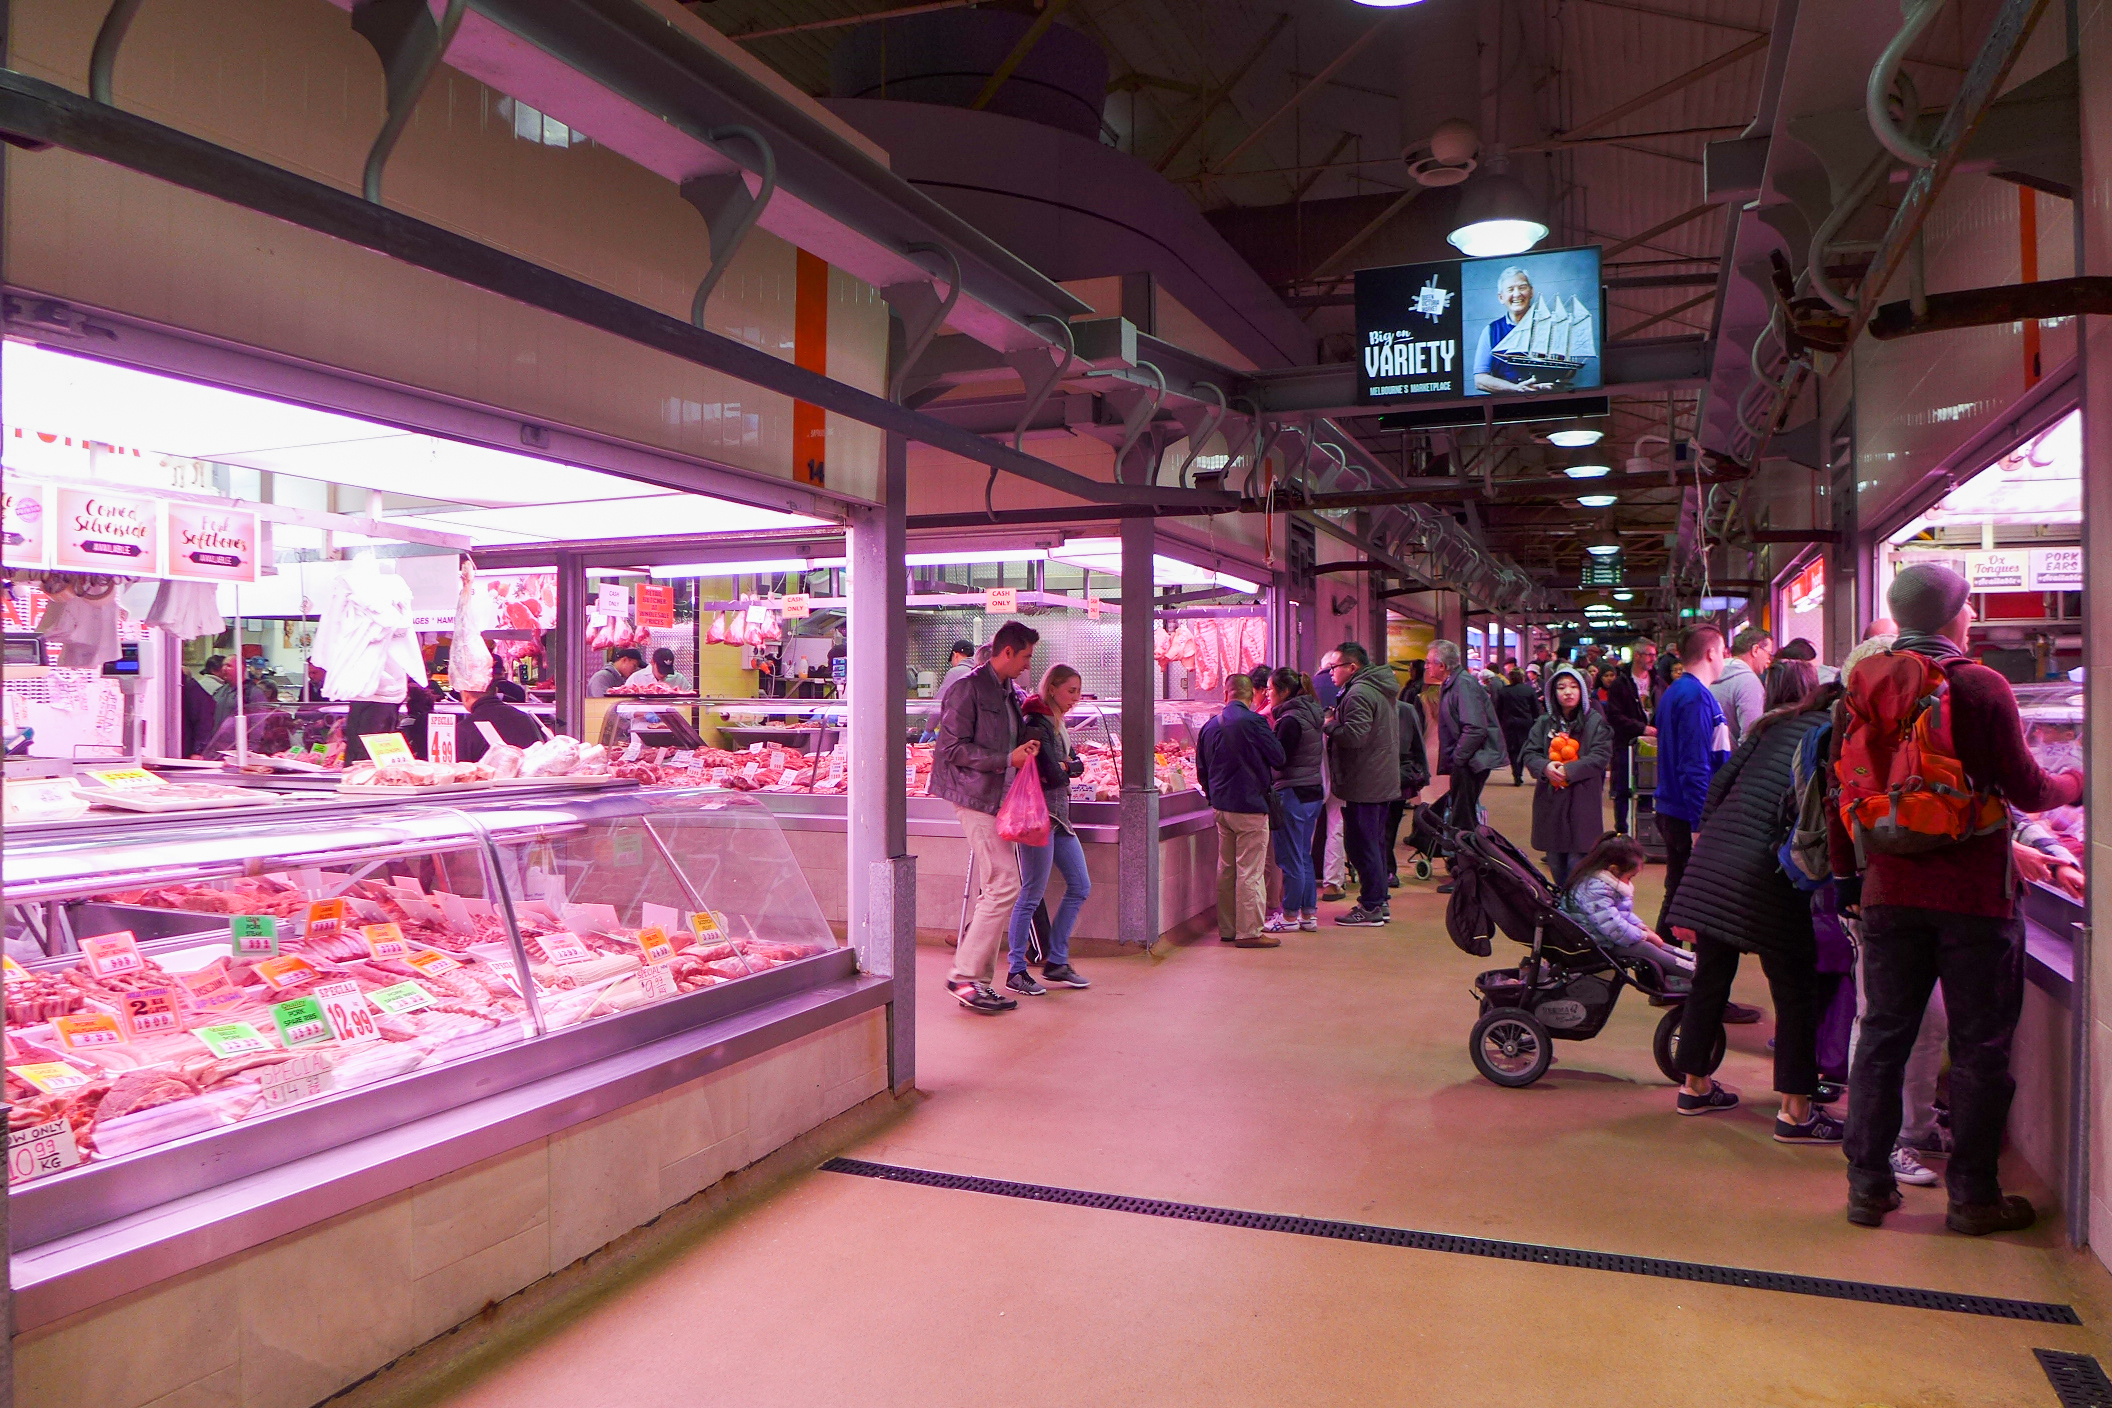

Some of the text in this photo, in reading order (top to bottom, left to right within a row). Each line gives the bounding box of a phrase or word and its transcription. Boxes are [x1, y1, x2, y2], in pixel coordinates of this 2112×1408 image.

[1369, 330, 1412, 346] Big on
[1364, 339, 1455, 378] VARIETY
[1369, 381, 1452, 396] MELBOURNE'S MARKETPLACE
[86, 499, 139, 521] Corned
[74, 515, 149, 538] Silverside
[1989, 554, 2006, 564] Ox
[2045, 552, 2079, 562] PORK
[1974, 563, 2019, 575] Tongues
[2045, 562, 2078, 571] EARS
[640, 610, 669, 618] WHOLESALE
[431, 716, 454, 725] SPECIAL
[637, 967, 661, 980] SPECIAL
[319, 982, 357, 998] SPECIAL
[130, 1000, 149, 1016] 2
[287, 1009, 305, 1017] PORK
[283, 1012, 318, 1026] SPARE RIBS
[261, 1051, 332, 1085] SPECIAL
[31, 1120, 64, 1139] ONLY
[41, 1157, 62, 1172] KG
